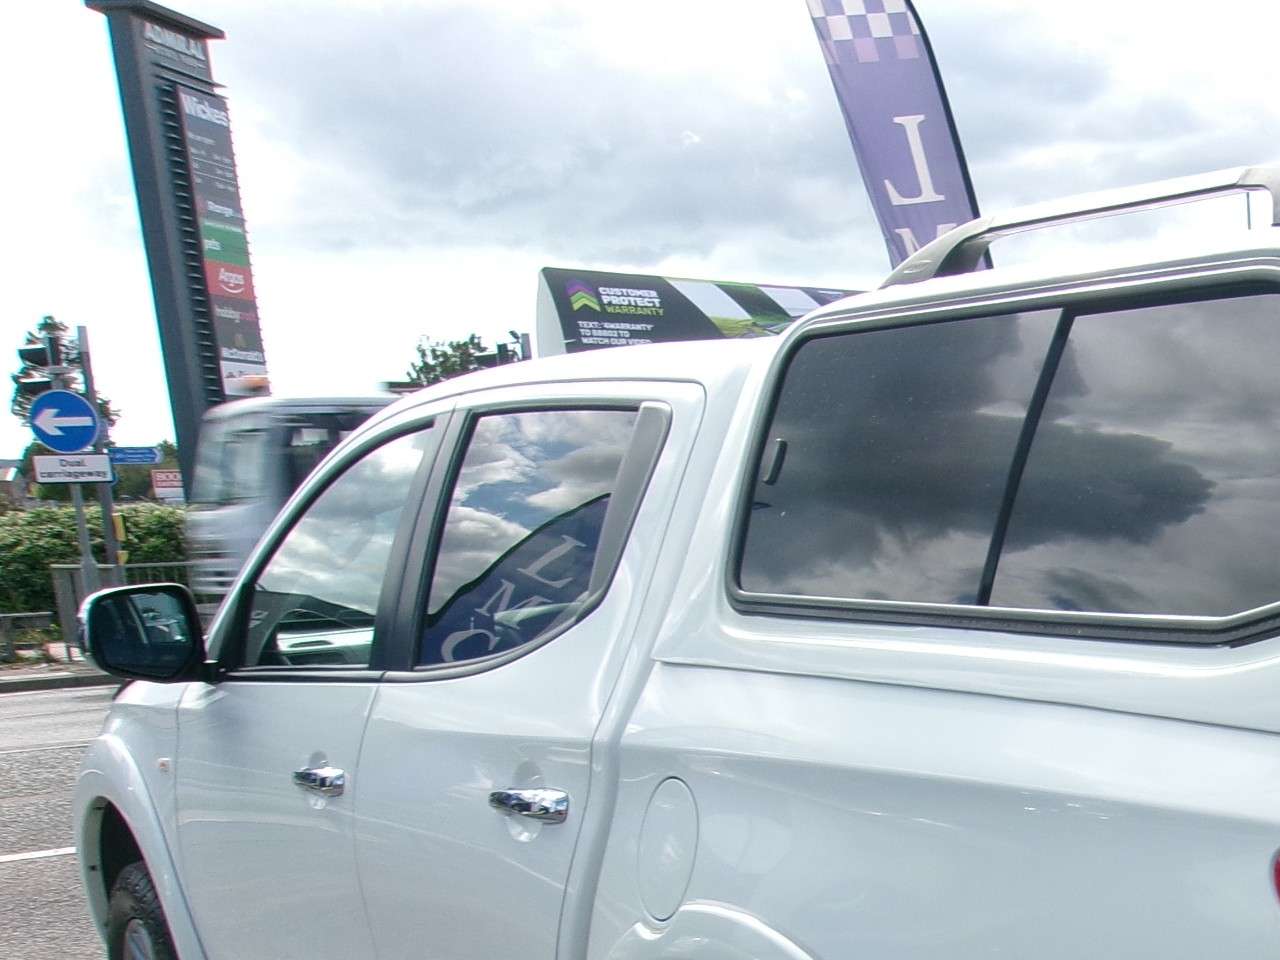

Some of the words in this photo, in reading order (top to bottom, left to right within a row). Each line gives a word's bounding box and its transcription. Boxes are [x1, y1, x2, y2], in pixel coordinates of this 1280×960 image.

[179, 92, 230, 128] Wickes
[218, 267, 245, 285] Argos
[598, 287, 658, 297] CUSTOMER
[601, 295, 661, 307] PROTECT
[604, 305, 664, 316] WARRANTY
[59, 458, 87, 468] Dual
[39, 470, 108, 480] carriageway
